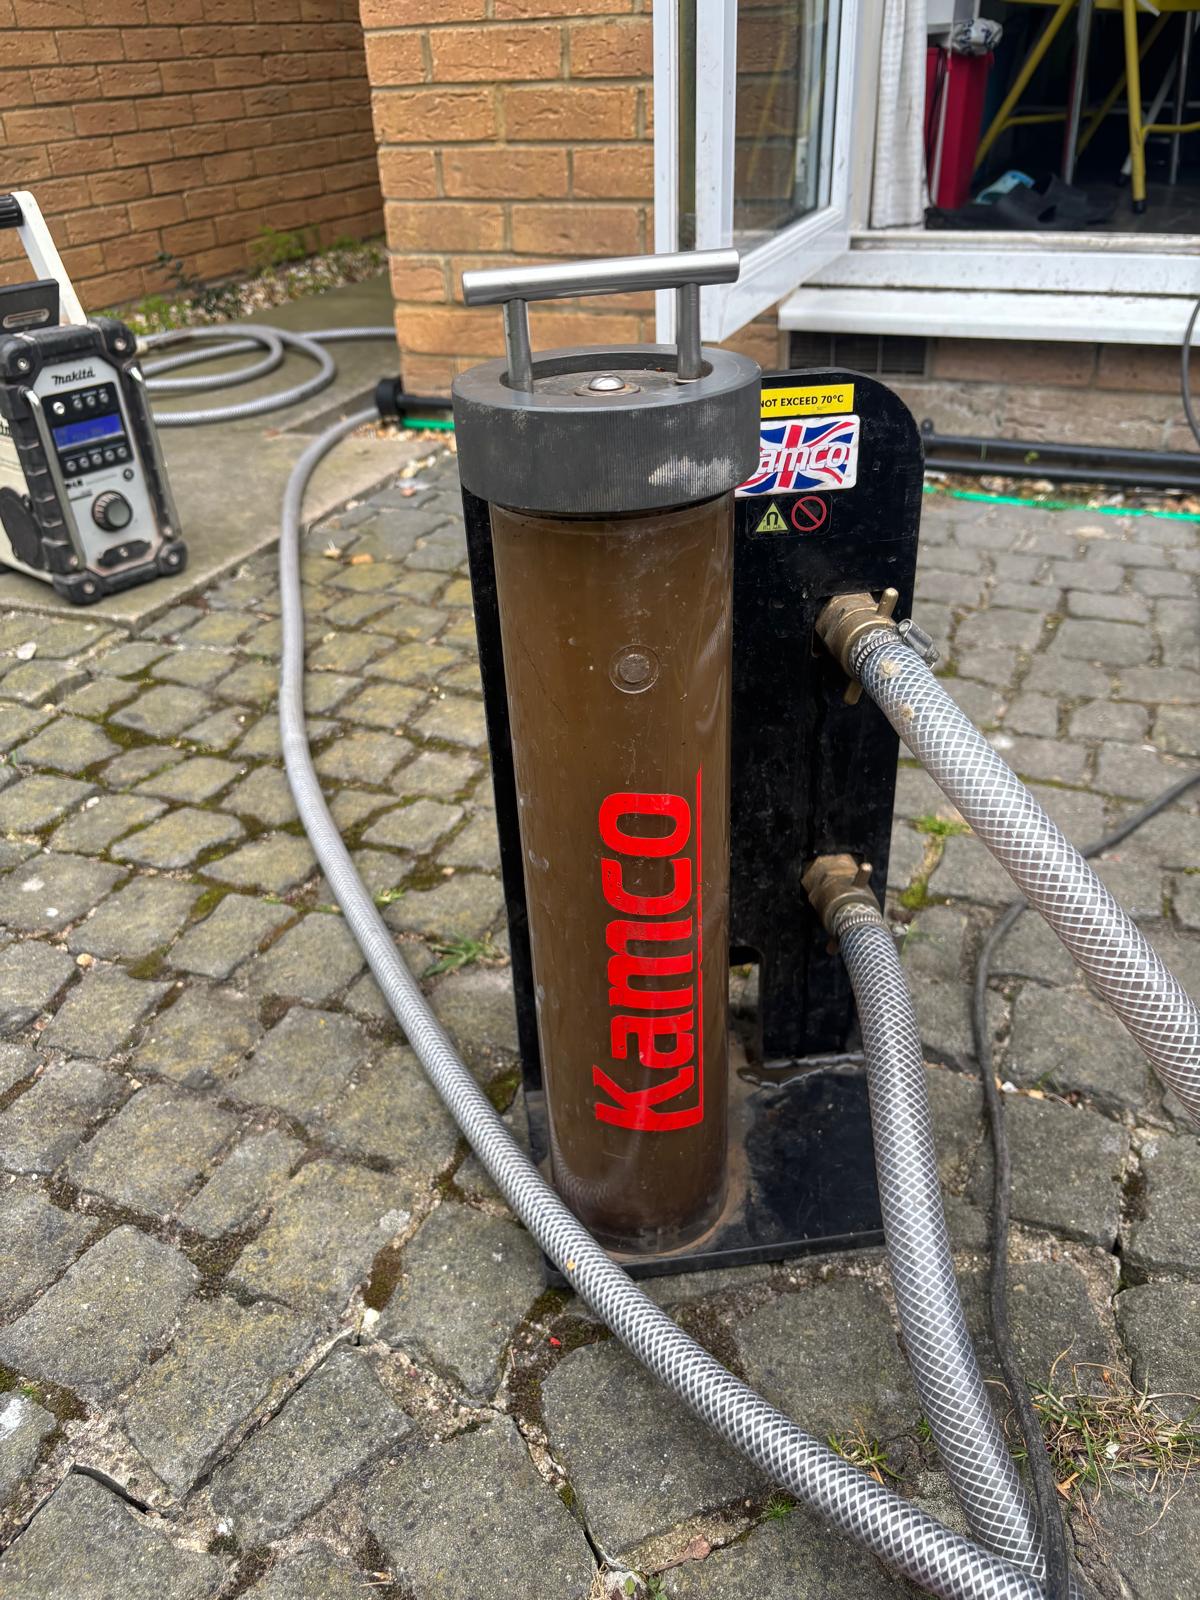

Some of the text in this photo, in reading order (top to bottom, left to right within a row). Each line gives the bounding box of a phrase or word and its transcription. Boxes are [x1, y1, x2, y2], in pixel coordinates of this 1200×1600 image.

[780, 396, 818, 407] EXCEED
[757, 443, 848, 474] amco
[593, 791, 703, 1132] Kamco
